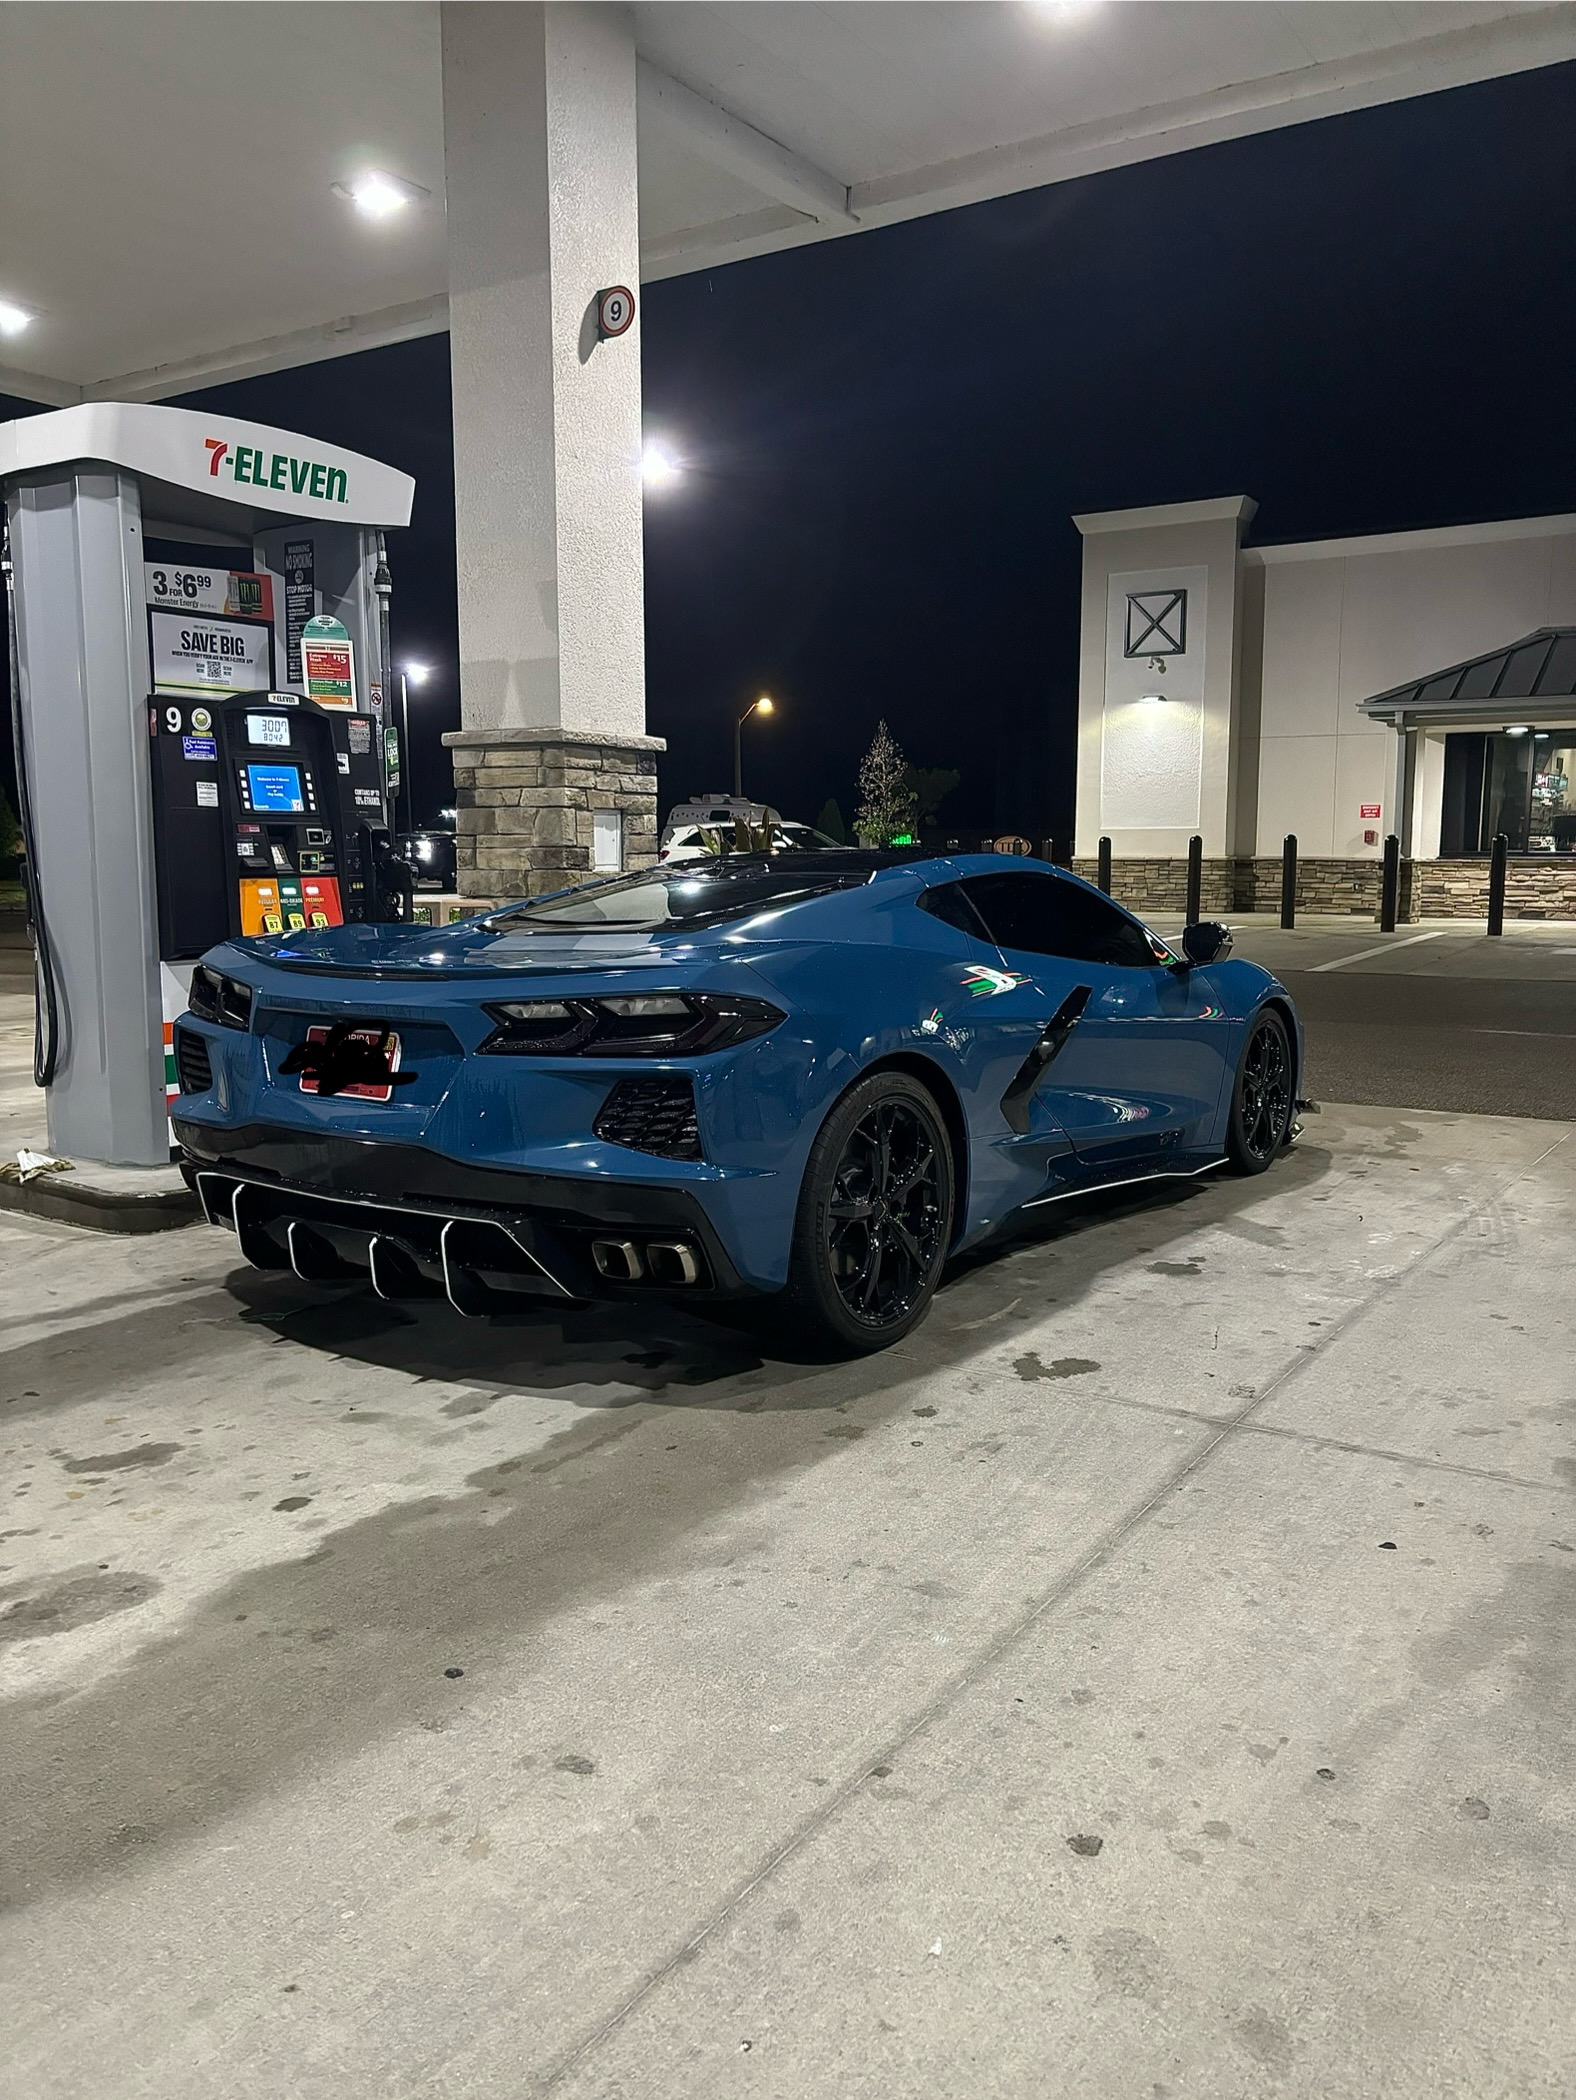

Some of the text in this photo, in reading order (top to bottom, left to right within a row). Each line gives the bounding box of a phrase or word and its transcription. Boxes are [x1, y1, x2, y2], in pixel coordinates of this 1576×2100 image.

[610, 300, 622, 322] 9
[286, 552, 312, 570] NO SMOKING
[153, 571, 168, 596] 3
[169, 588, 183, 598] FOR
[286, 586, 297, 595] STOP
[180, 598, 199, 609] Energy
[181, 630, 245, 657] SAVE BIG
[333, 654, 347, 664] $15
[166, 706, 182, 733] 9
